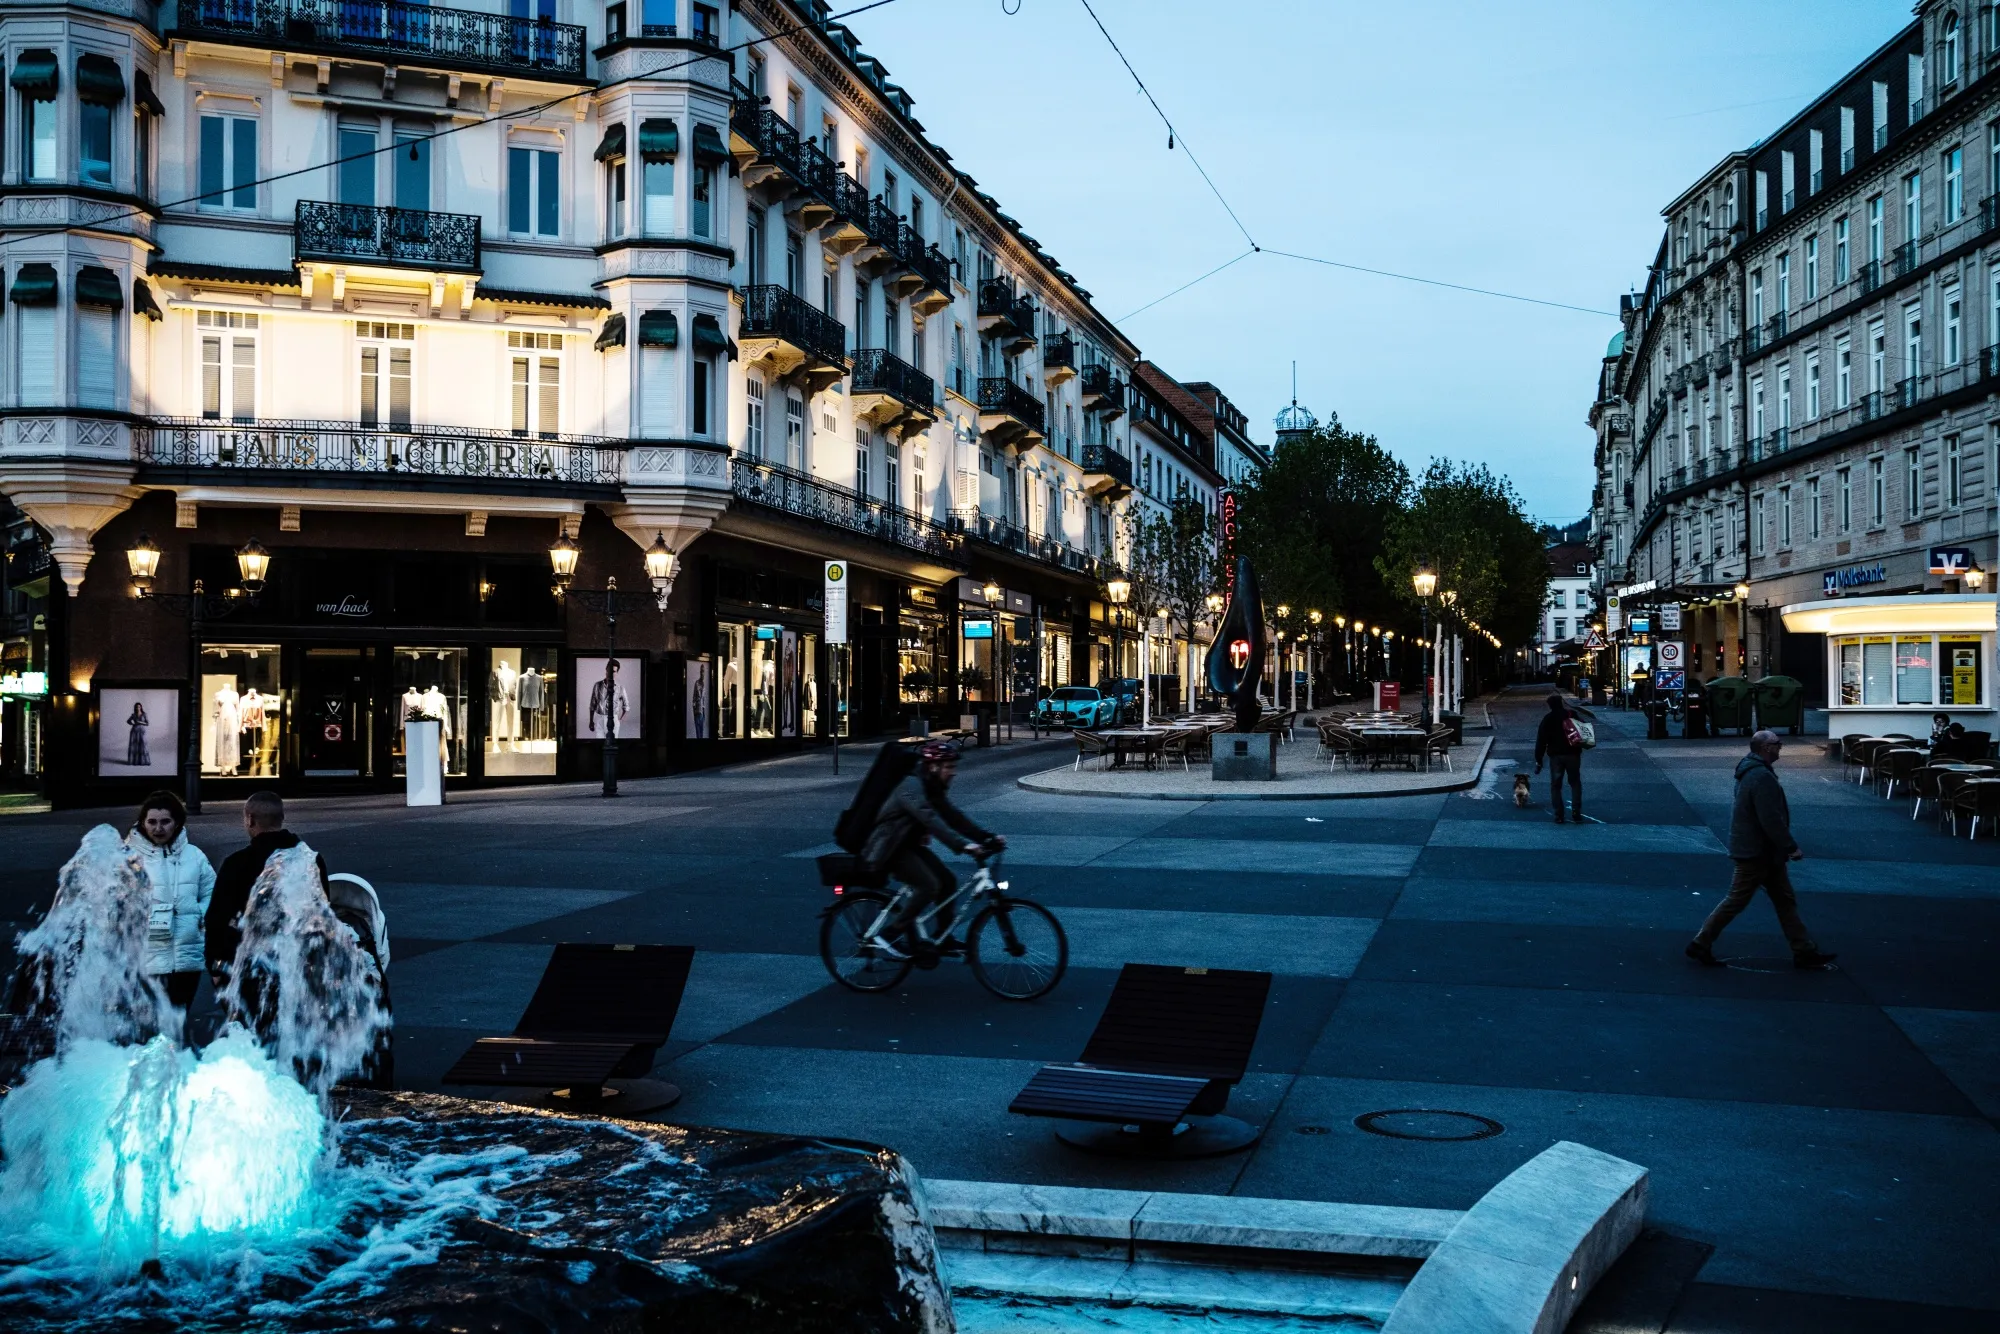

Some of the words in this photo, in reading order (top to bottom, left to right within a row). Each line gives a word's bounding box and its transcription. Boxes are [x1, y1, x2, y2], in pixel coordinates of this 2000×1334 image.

[216, 434, 316, 464] HAUS
[352, 437, 556, 479] VICTORIA
[1838, 562, 1886, 587] Volksbank
[316, 603, 337, 612] van
[332, 595, 374, 617] Laack
[1665, 648, 1675, 657] 30
